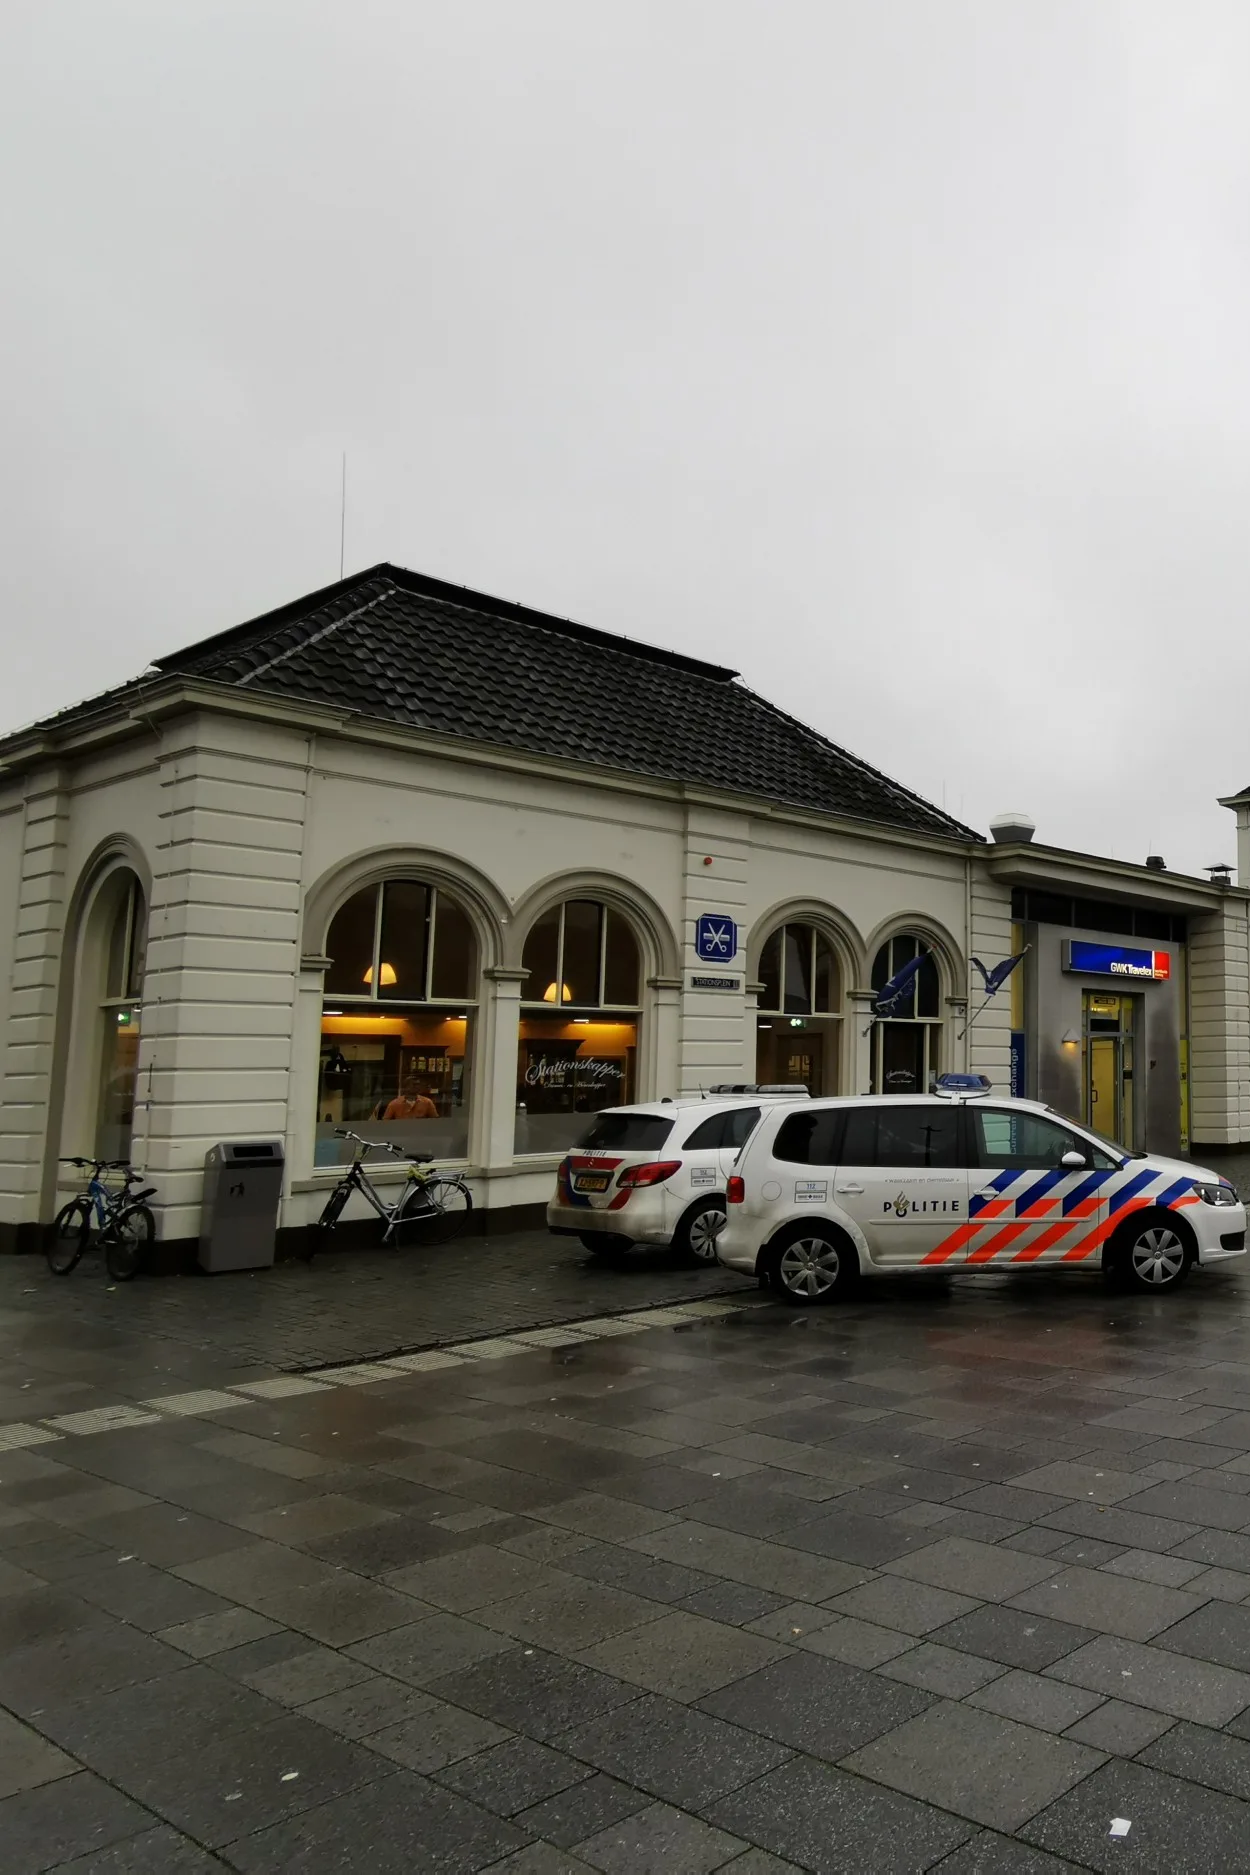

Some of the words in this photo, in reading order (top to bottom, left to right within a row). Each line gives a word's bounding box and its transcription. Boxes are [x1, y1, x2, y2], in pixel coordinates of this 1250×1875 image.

[1110, 962, 1128, 974] GWK
[1128, 964, 1152, 976] Travelex
[883, 1200, 960, 1218] POLITIE
